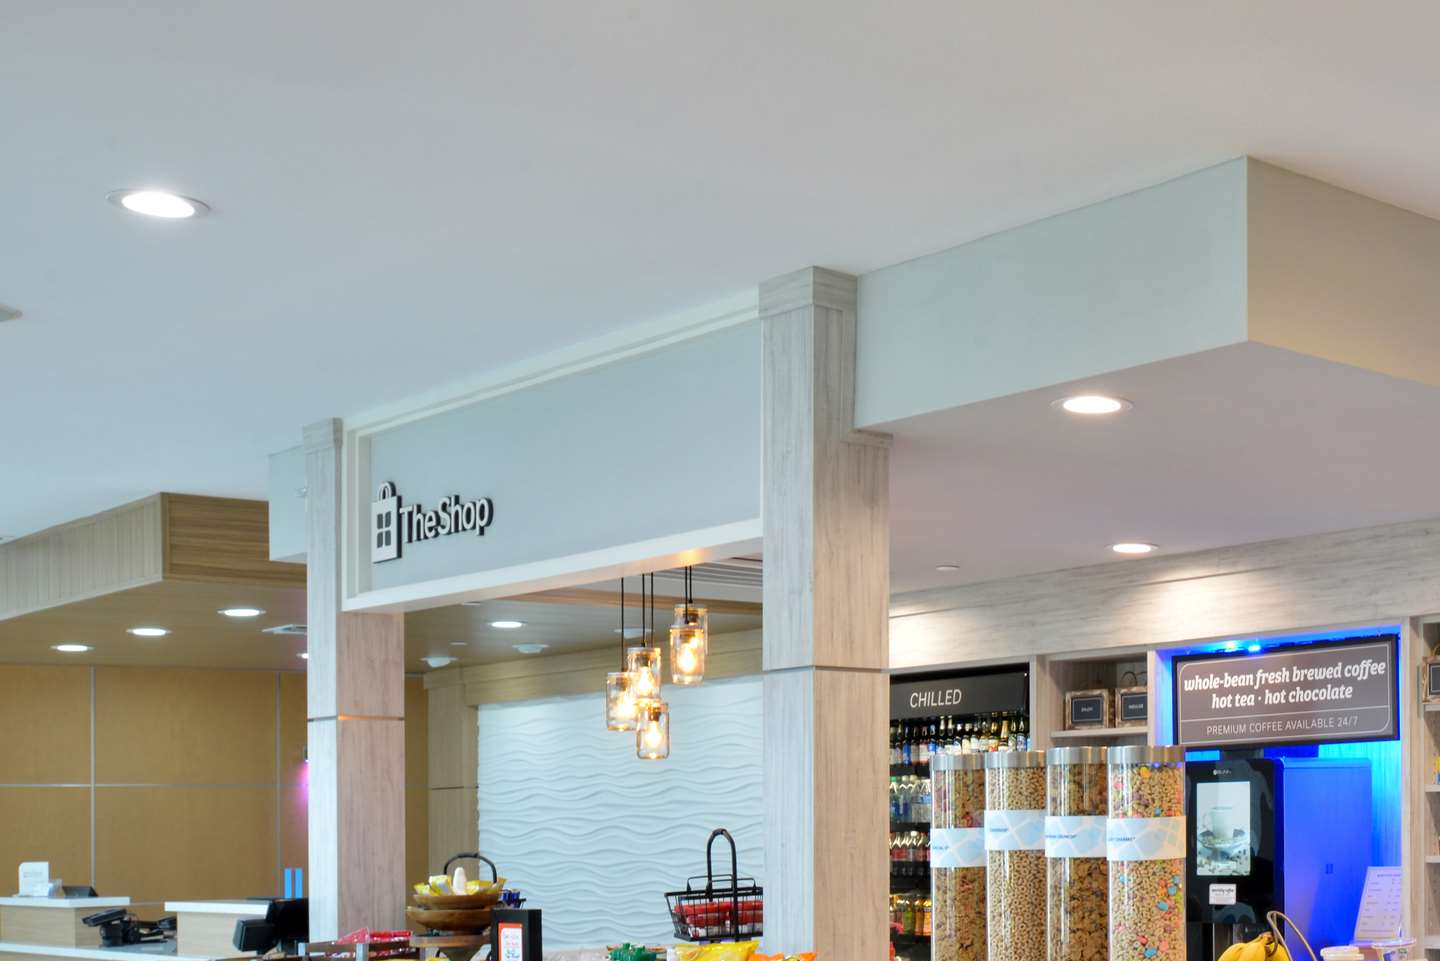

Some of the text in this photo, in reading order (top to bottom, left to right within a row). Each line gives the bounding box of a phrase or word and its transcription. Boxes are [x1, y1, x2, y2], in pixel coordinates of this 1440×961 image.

[1184, 659, 1386, 691] whole-bean fresh brewed coffee
[909, 689, 962, 708] CHILLED
[1211, 684, 1353, 709] hot tea hot chocolate
[1206, 715, 1359, 736] PREMIUM COFFEE AVAILABLE 24/7
